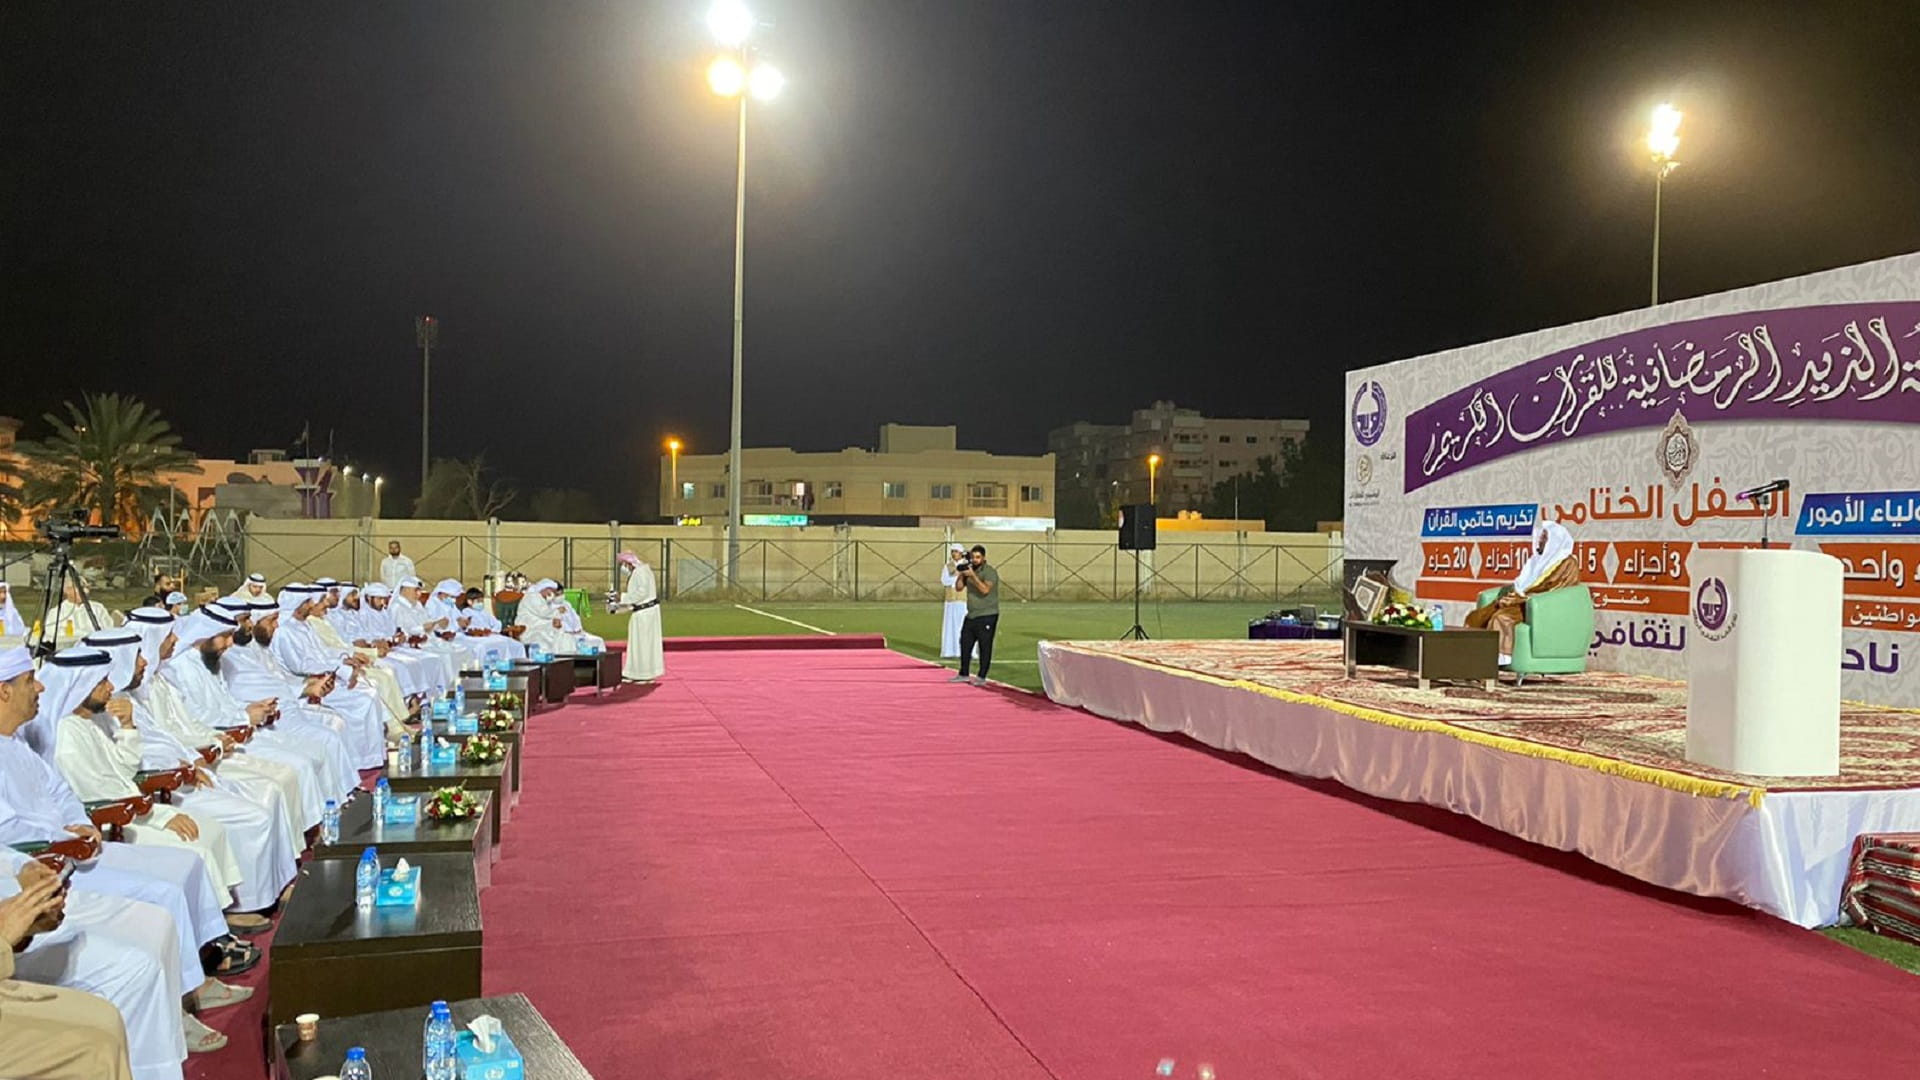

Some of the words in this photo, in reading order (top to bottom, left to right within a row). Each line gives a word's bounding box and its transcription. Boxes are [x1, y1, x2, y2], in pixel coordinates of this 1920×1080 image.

[1423, 388, 1505, 475] الكريم
[1673, 477, 1789, 527] الحفل
[1806, 496, 1864, 528] الأمور
[1428, 509, 1458, 531] القرآن
[1459, 509, 1495, 536] خاتمي
[1496, 509, 1533, 531] تكريم
[1428, 548, 1452, 575] جزء
[1453, 546, 1467, 569] 20
[1485, 543, 1514, 575] أجزاء
[1588, 547, 1597, 572] 5
[1624, 545, 1668, 580] أجزاء
[1670, 550, 1681, 578] 3
[1844, 550, 1904, 588] واحد
[1593, 590, 1650, 608] مفتوح
